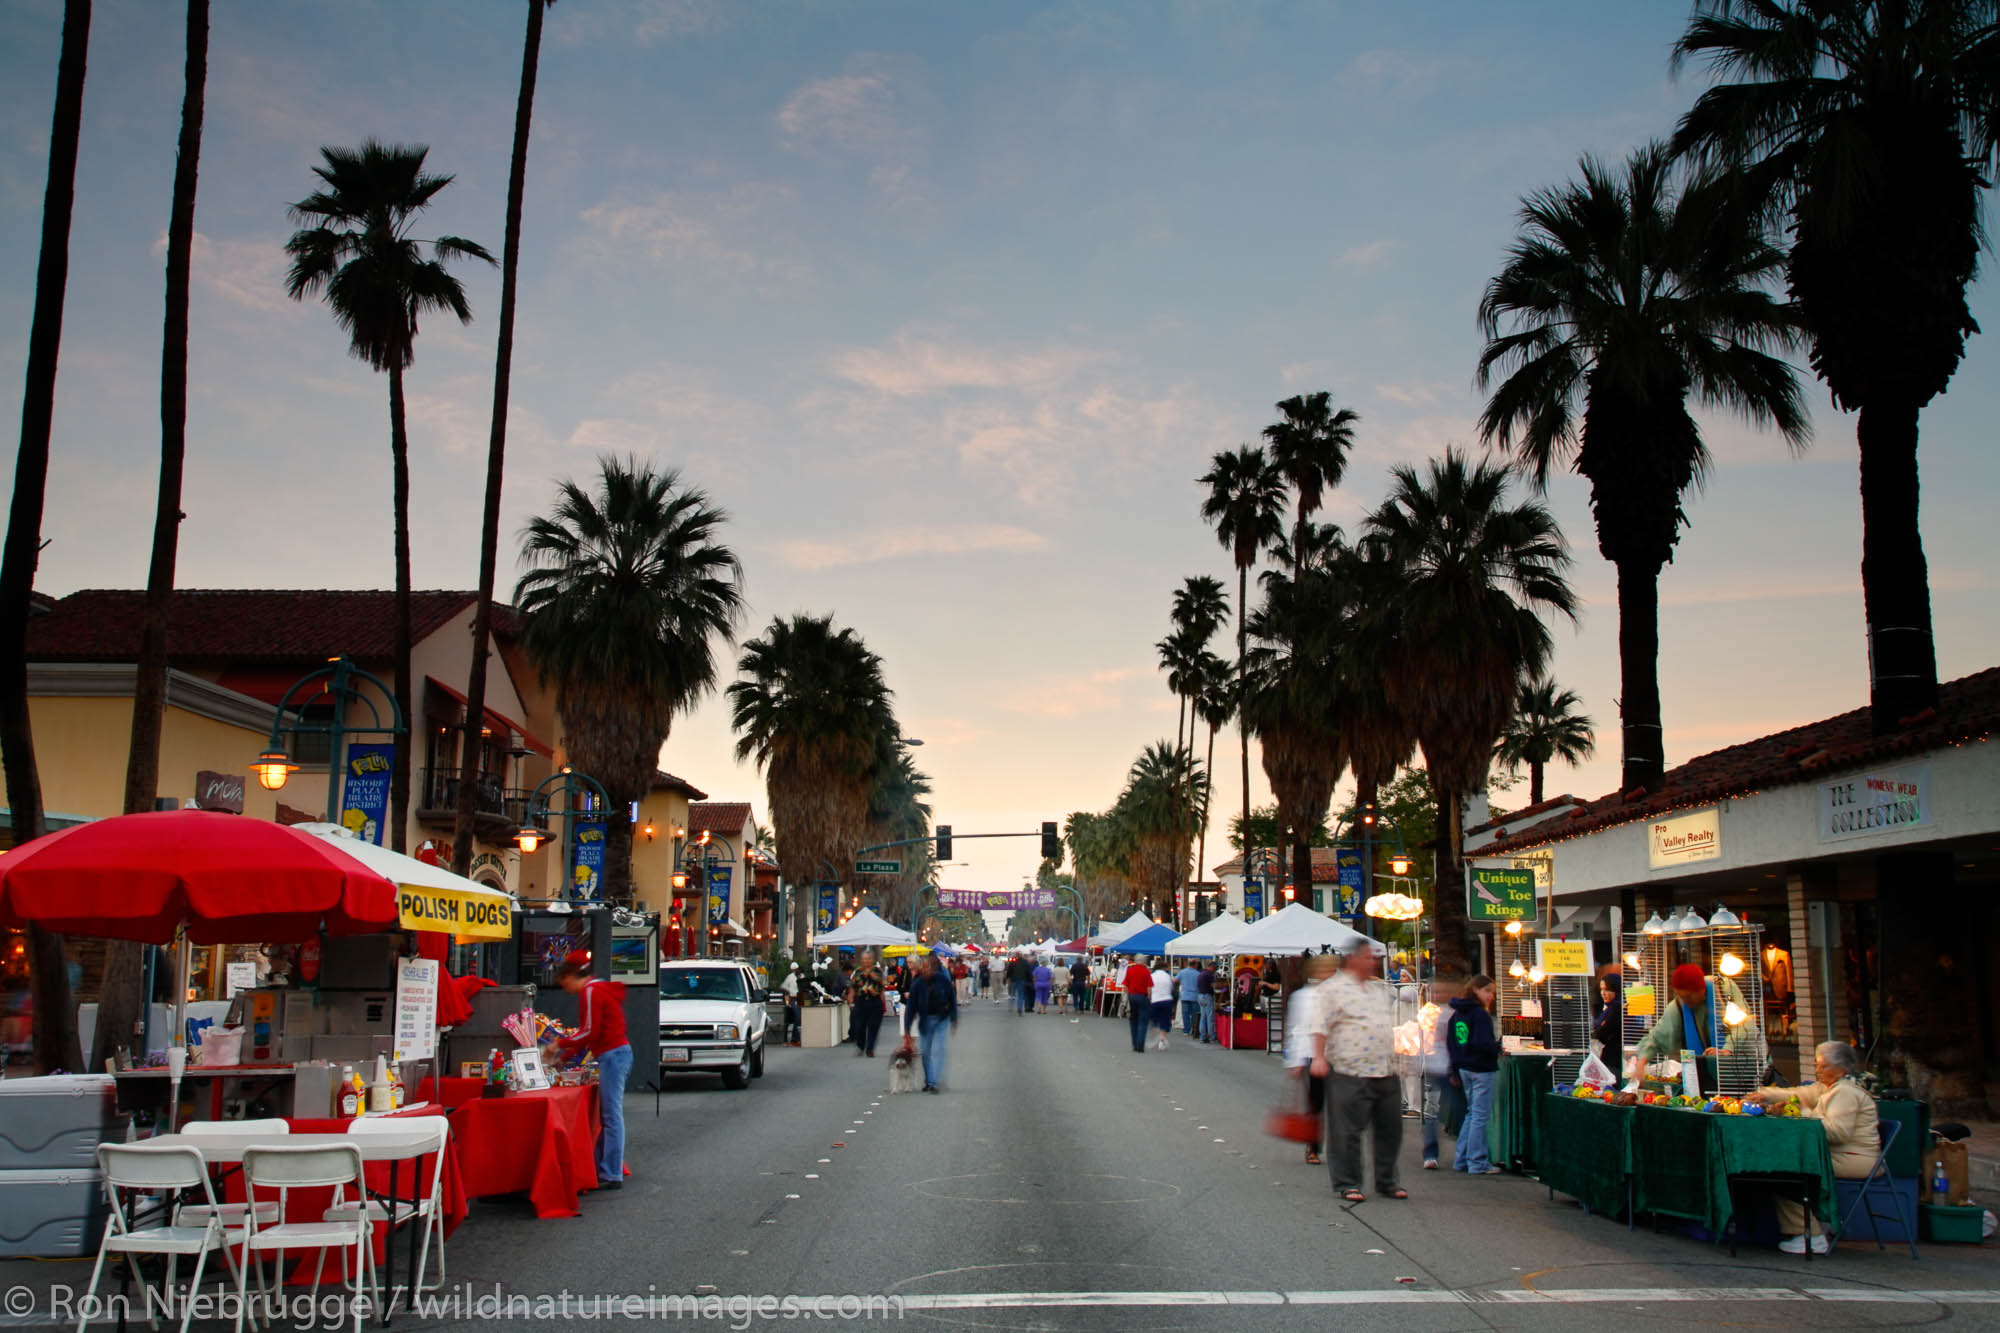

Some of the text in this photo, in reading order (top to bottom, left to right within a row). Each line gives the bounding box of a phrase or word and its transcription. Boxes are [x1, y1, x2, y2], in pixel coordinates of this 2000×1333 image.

[1829, 784, 1856, 807] THE
[1898, 783, 1917, 796] WEAR
[1832, 799, 1920, 834] COLLECTION
[1655, 825, 1667, 834] Pro
[1663, 830, 1714, 848] Valley Realty
[873, 863, 894, 871] Plaza
[1479, 871, 1528, 886] Unique
[1507, 889, 1532, 901] Toe
[401, 893, 509, 926] POLISH DOGS
[1485, 904, 1524, 919] Rings
